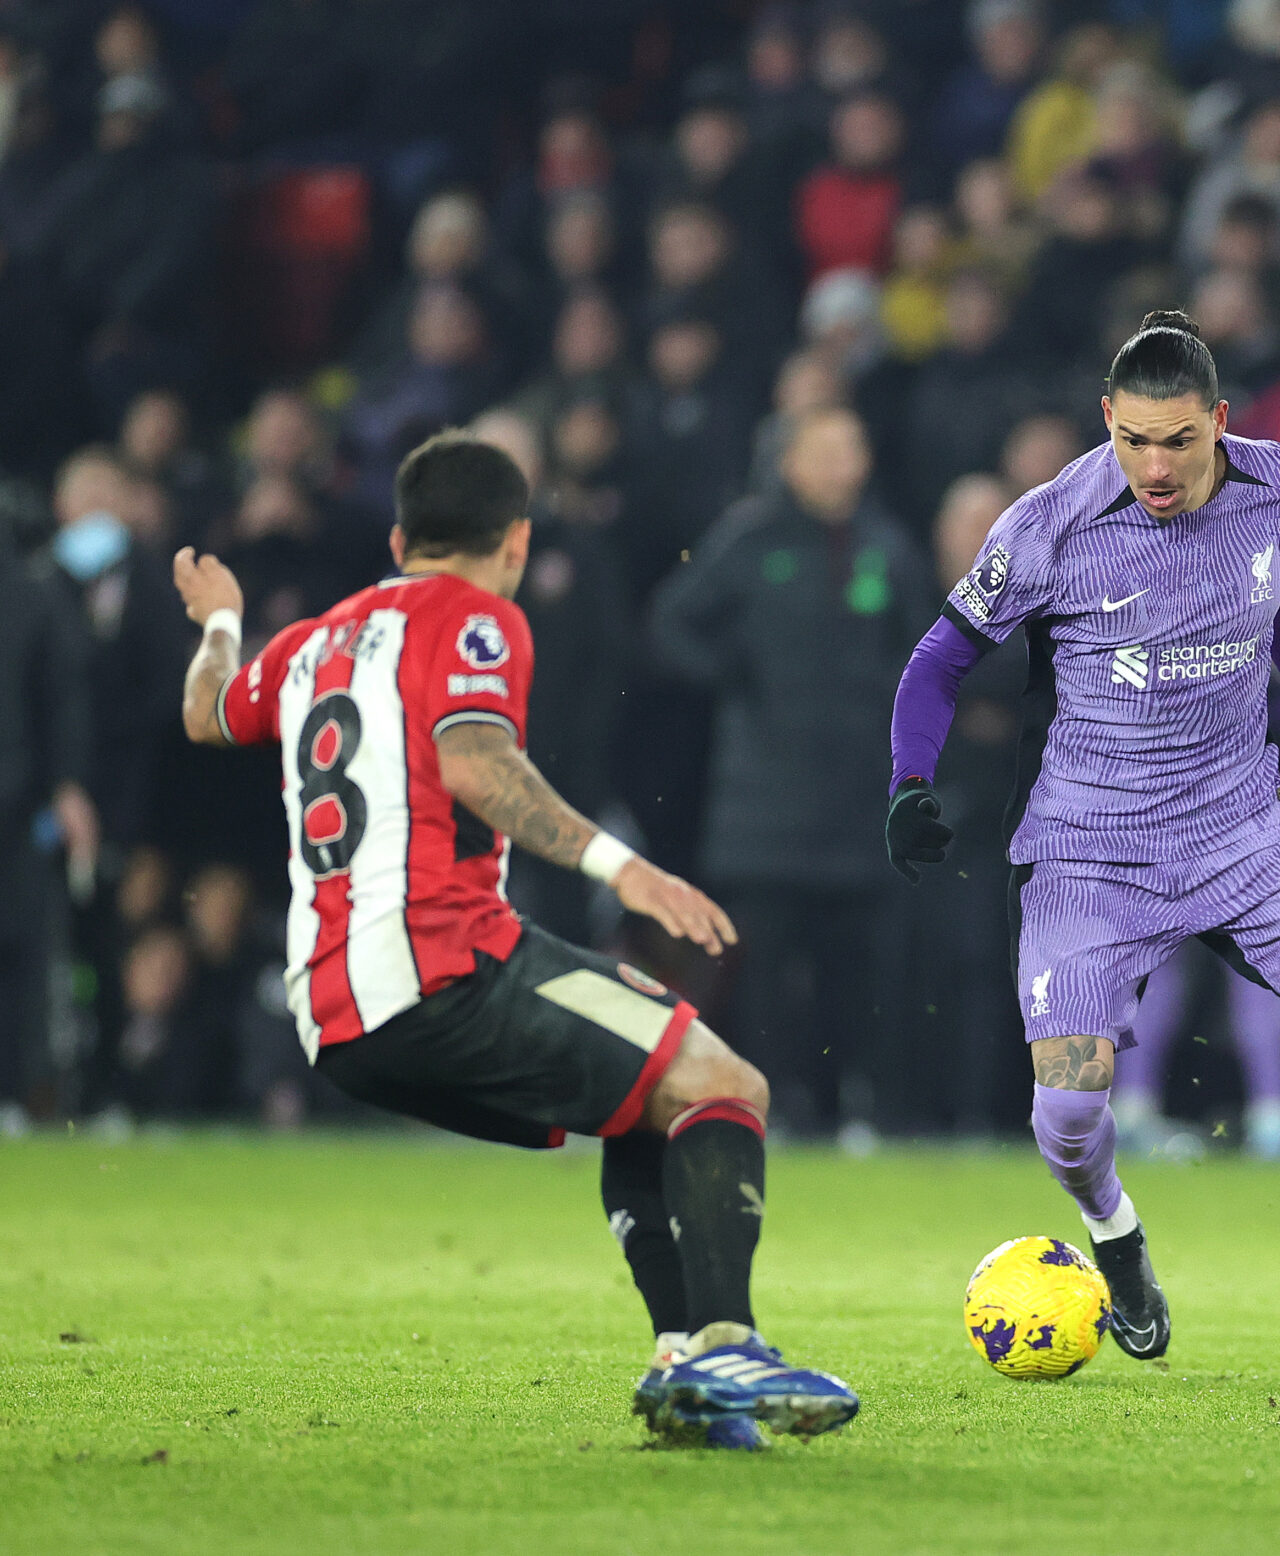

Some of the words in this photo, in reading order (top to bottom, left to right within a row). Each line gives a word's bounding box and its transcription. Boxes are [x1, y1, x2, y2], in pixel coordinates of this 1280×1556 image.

[1160, 634, 1260, 663] standard
[1158, 649, 1254, 681] chartered
[297, 689, 368, 875] 8
